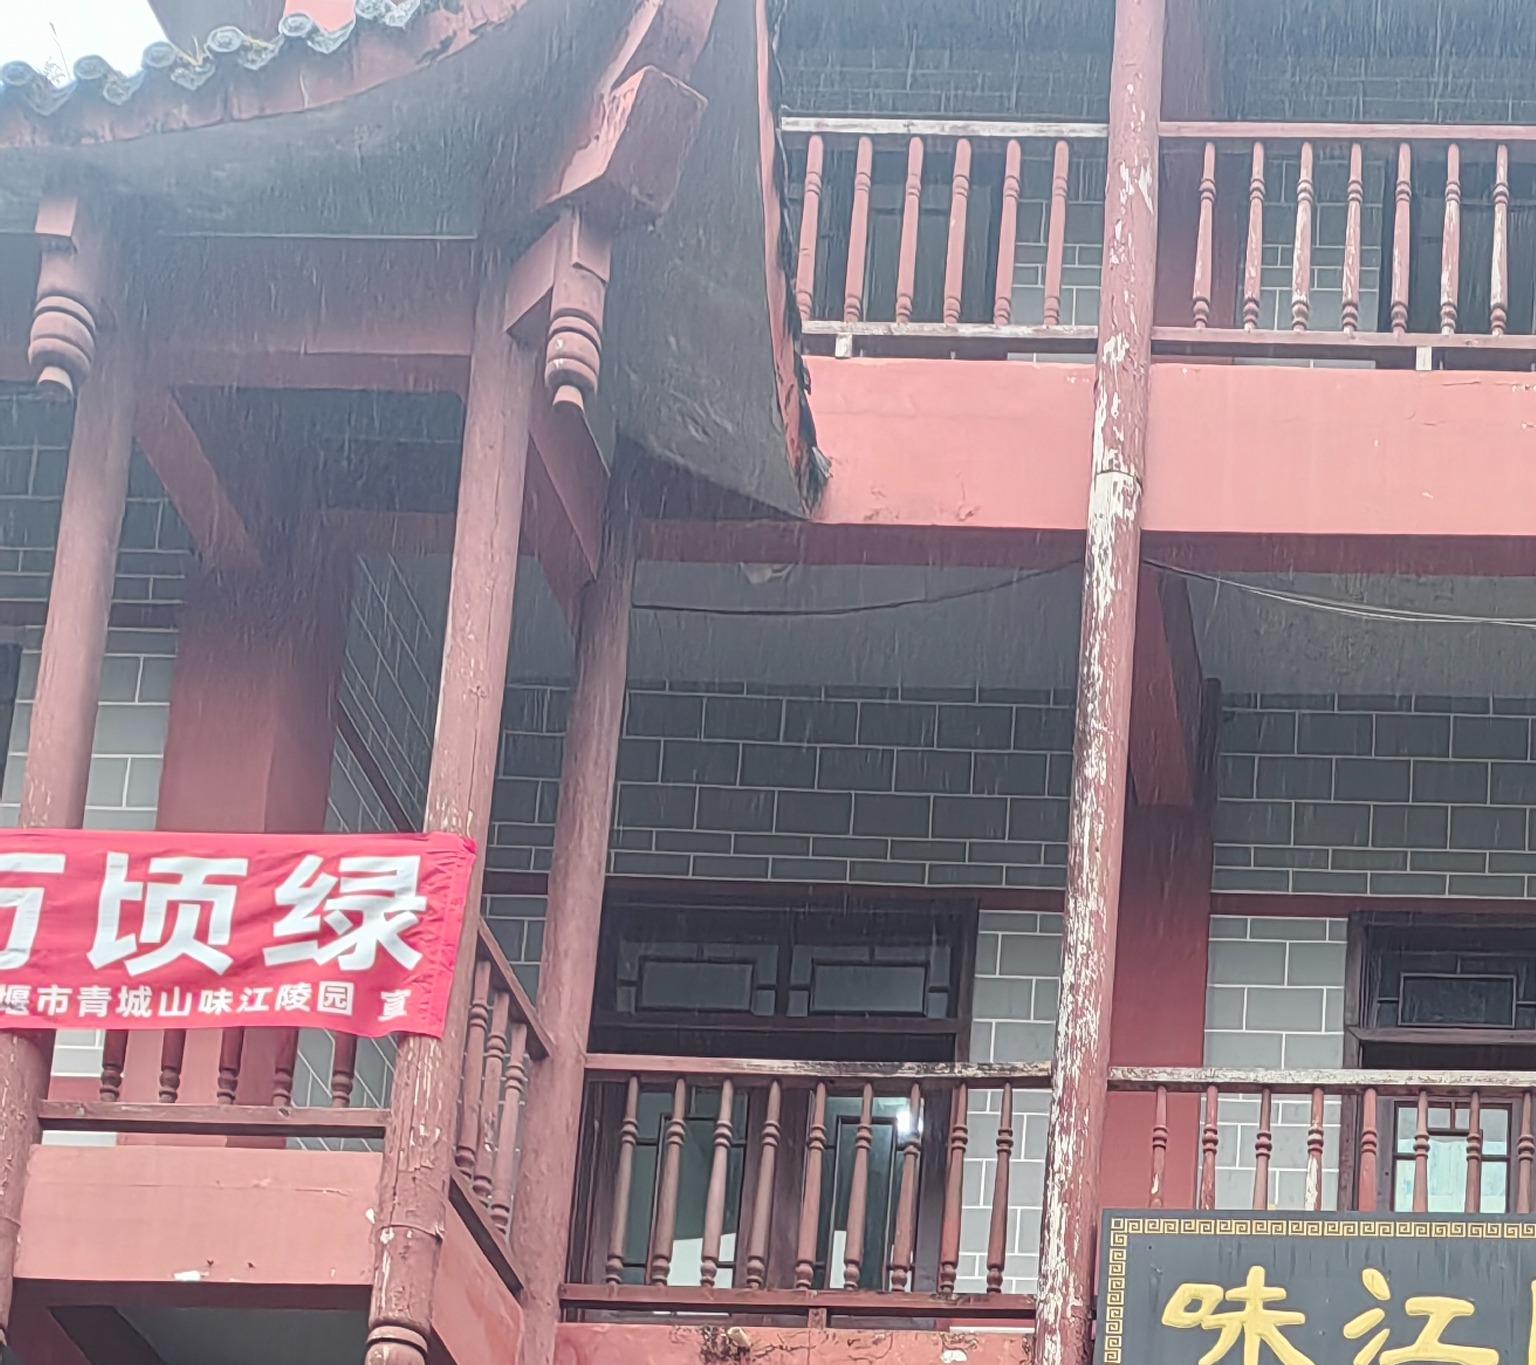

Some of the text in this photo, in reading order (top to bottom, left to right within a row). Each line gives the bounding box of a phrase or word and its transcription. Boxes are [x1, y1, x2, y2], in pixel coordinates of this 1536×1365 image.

[0, 981, 355, 1018] 堰市青城山味江陵园
